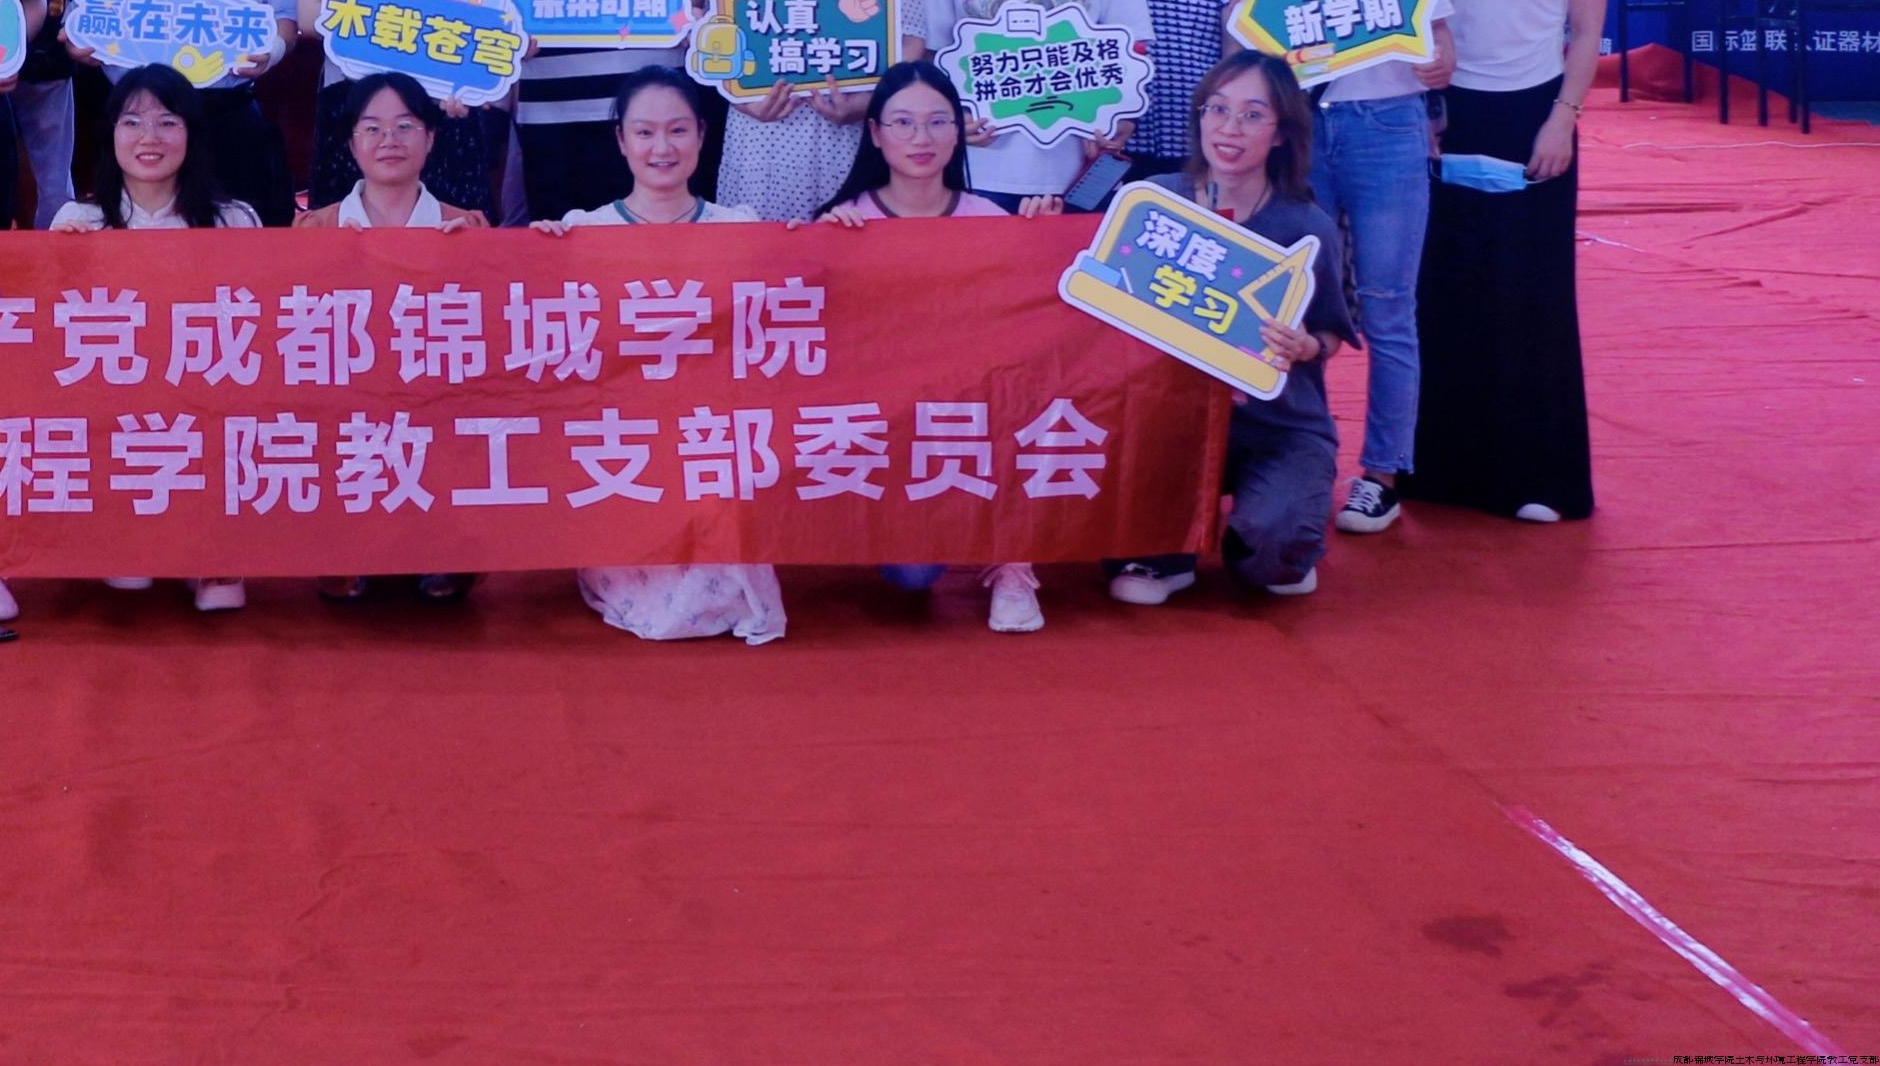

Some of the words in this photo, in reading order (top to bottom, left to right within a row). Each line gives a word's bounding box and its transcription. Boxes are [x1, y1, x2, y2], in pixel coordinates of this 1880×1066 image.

[769, 37, 879, 74] 搞学习
[971, 38, 1120, 77] 努力只能及格
[974, 63, 1124, 102] 拼命才会优秀
[1135, 210, 1229, 281] 深度
[1149, 264, 1239, 335] 学习
